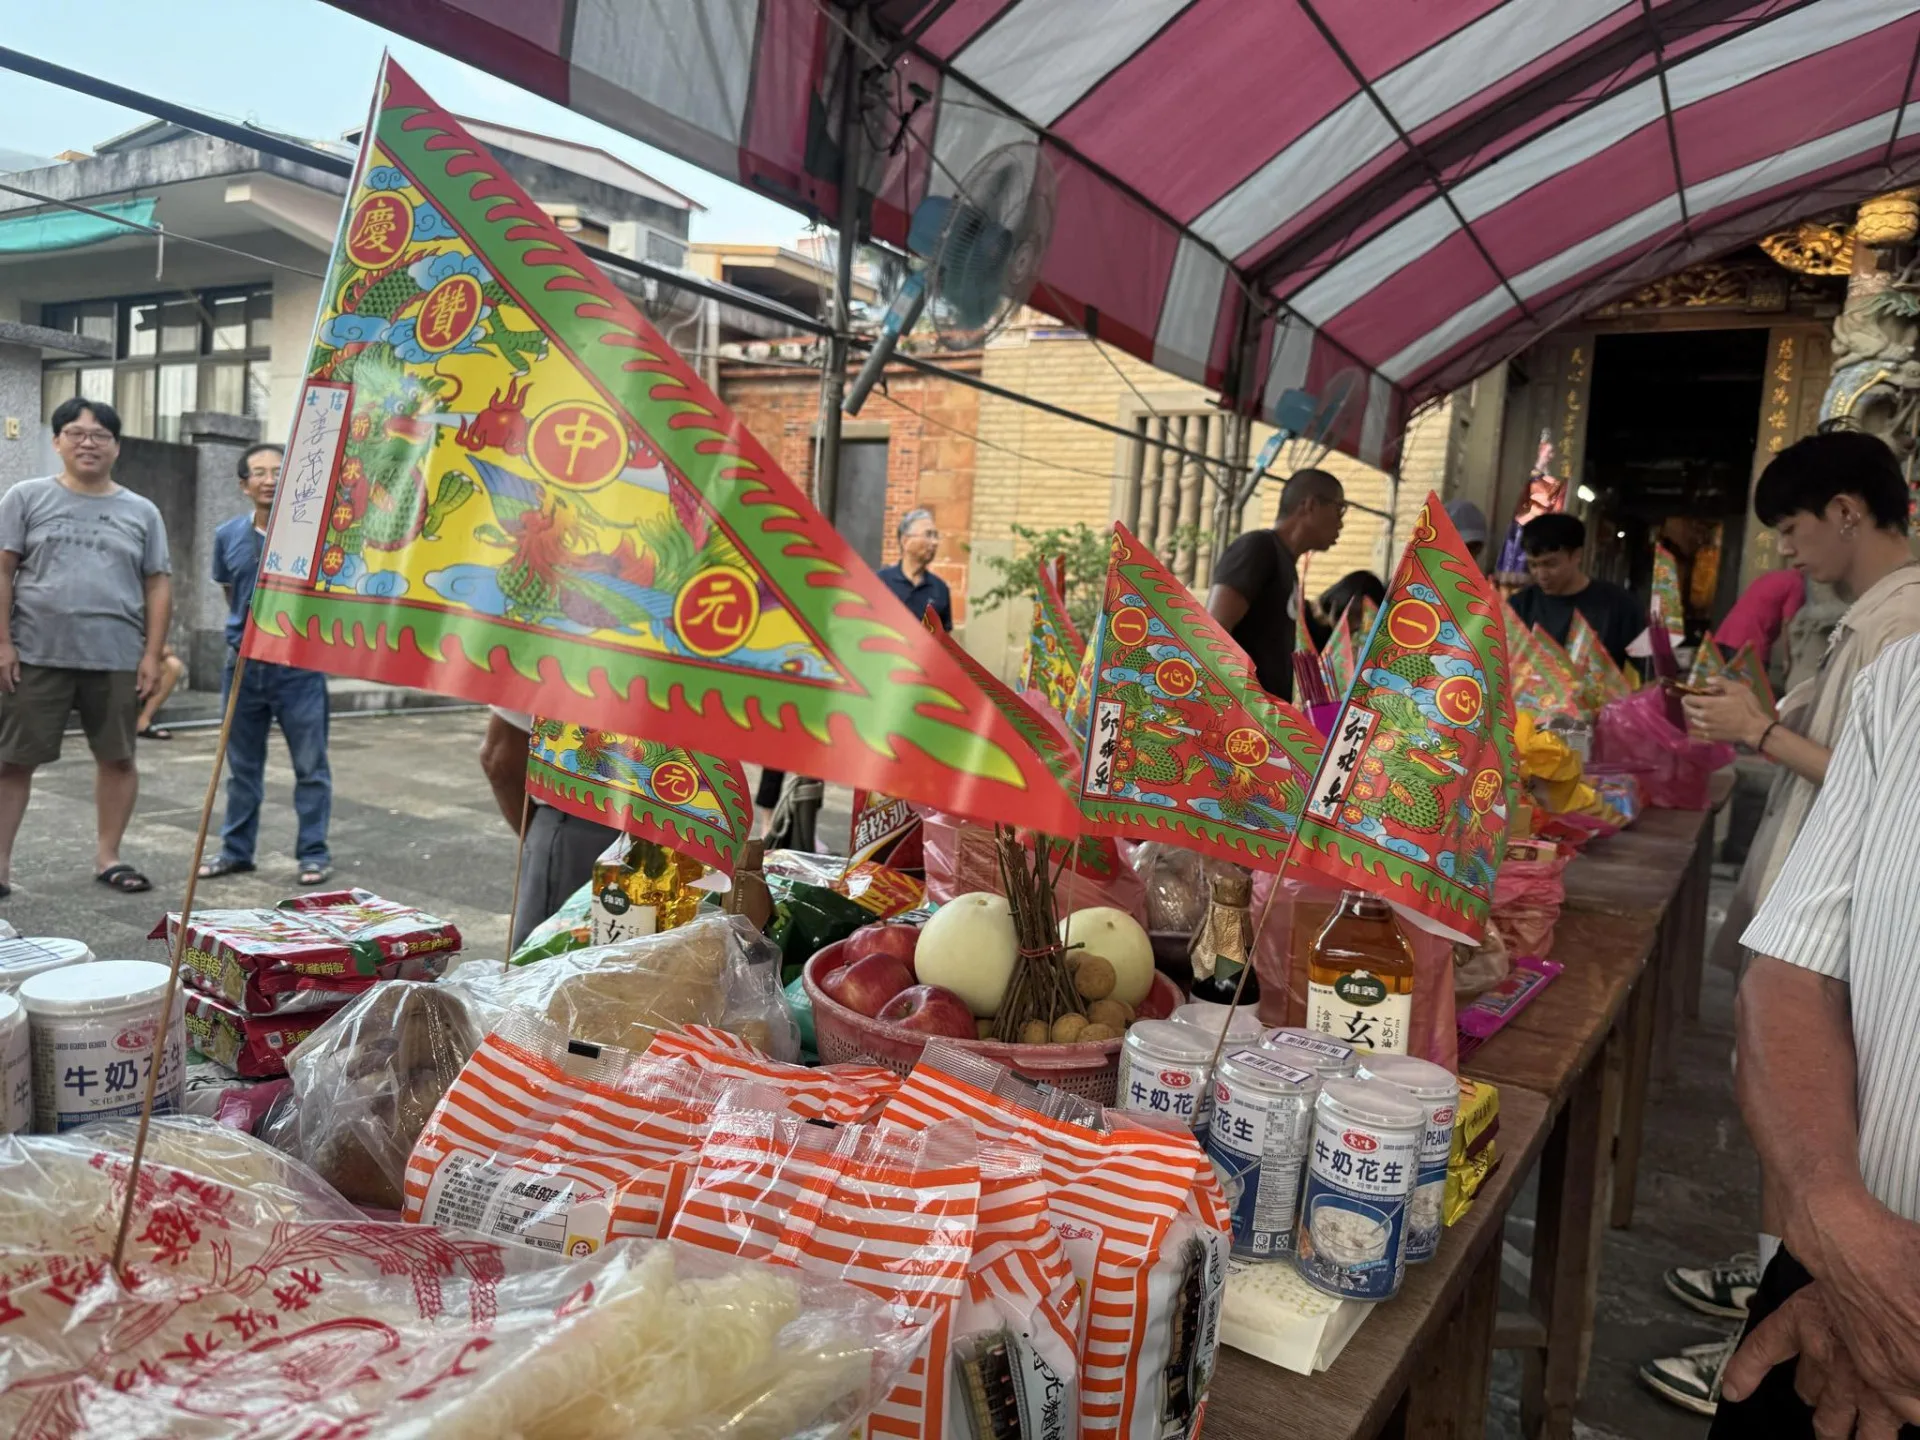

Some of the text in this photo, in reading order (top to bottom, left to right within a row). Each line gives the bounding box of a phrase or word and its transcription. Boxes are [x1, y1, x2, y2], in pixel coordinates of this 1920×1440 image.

[351, 199, 396, 253] 慶
[555, 411, 609, 476] 中
[686, 580, 743, 635] 元
[1230, 731, 1261, 762] 誠
[657, 768, 689, 798] 元
[1339, 1010, 1379, 1049] 玄
[1315, 1138, 1404, 1184] 牛奶花生
